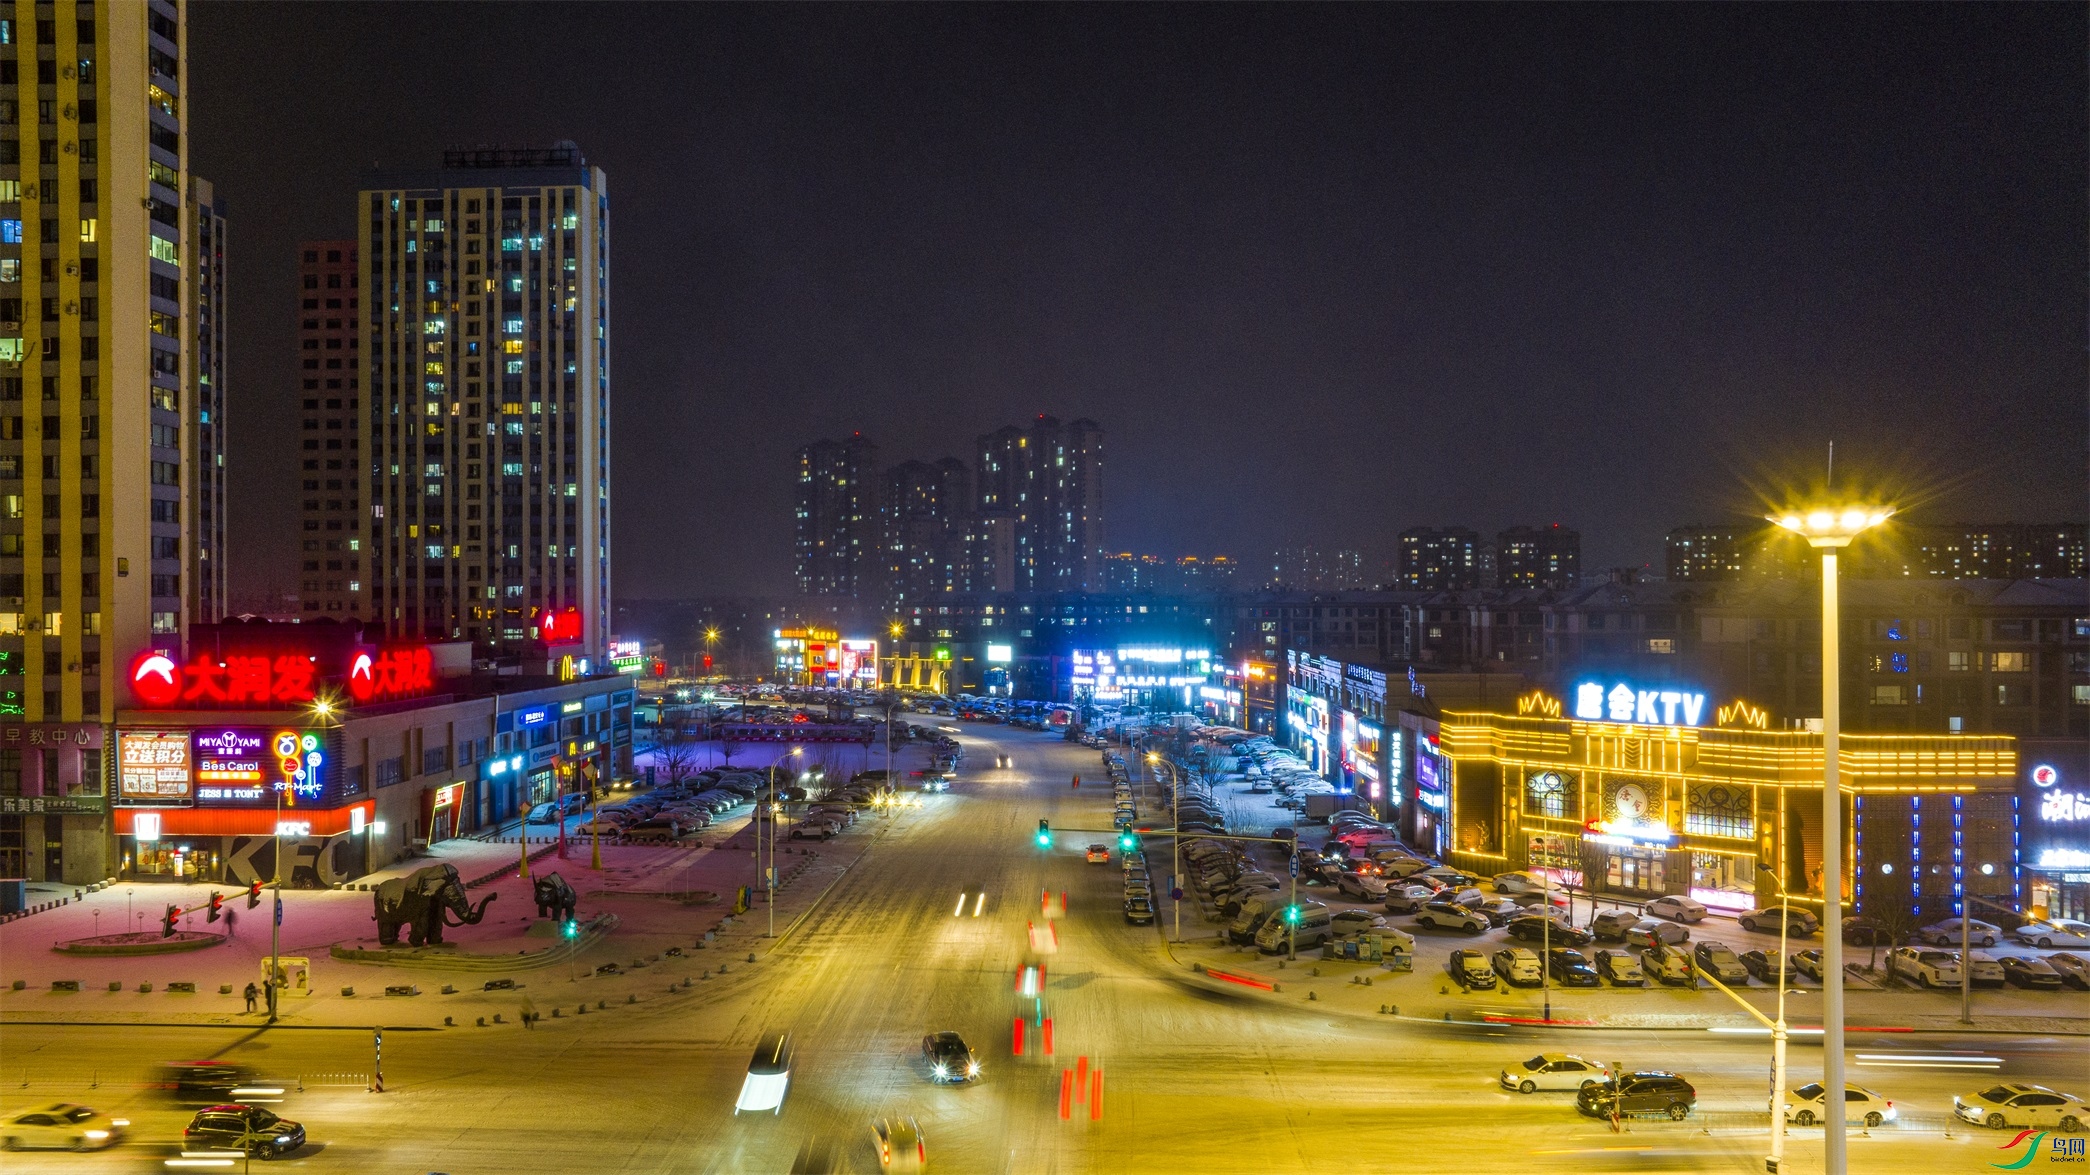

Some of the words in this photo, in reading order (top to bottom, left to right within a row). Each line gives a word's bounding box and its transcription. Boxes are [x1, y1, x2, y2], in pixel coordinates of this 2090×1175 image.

[184, 655, 315, 700] 大润发
[375, 650, 431, 693] 大润发
[6, 728, 90, 745] 早教中心
[124, 750, 185, 763] 立送积分
[227, 762, 258, 771] Carol
[198, 789, 222, 798] JESS
[273, 782, 323, 791] RT-Mart
[4, 798, 44, 812] 乐美家
[277, 822, 310, 836] KFC
[222, 836, 350, 889] KFC
